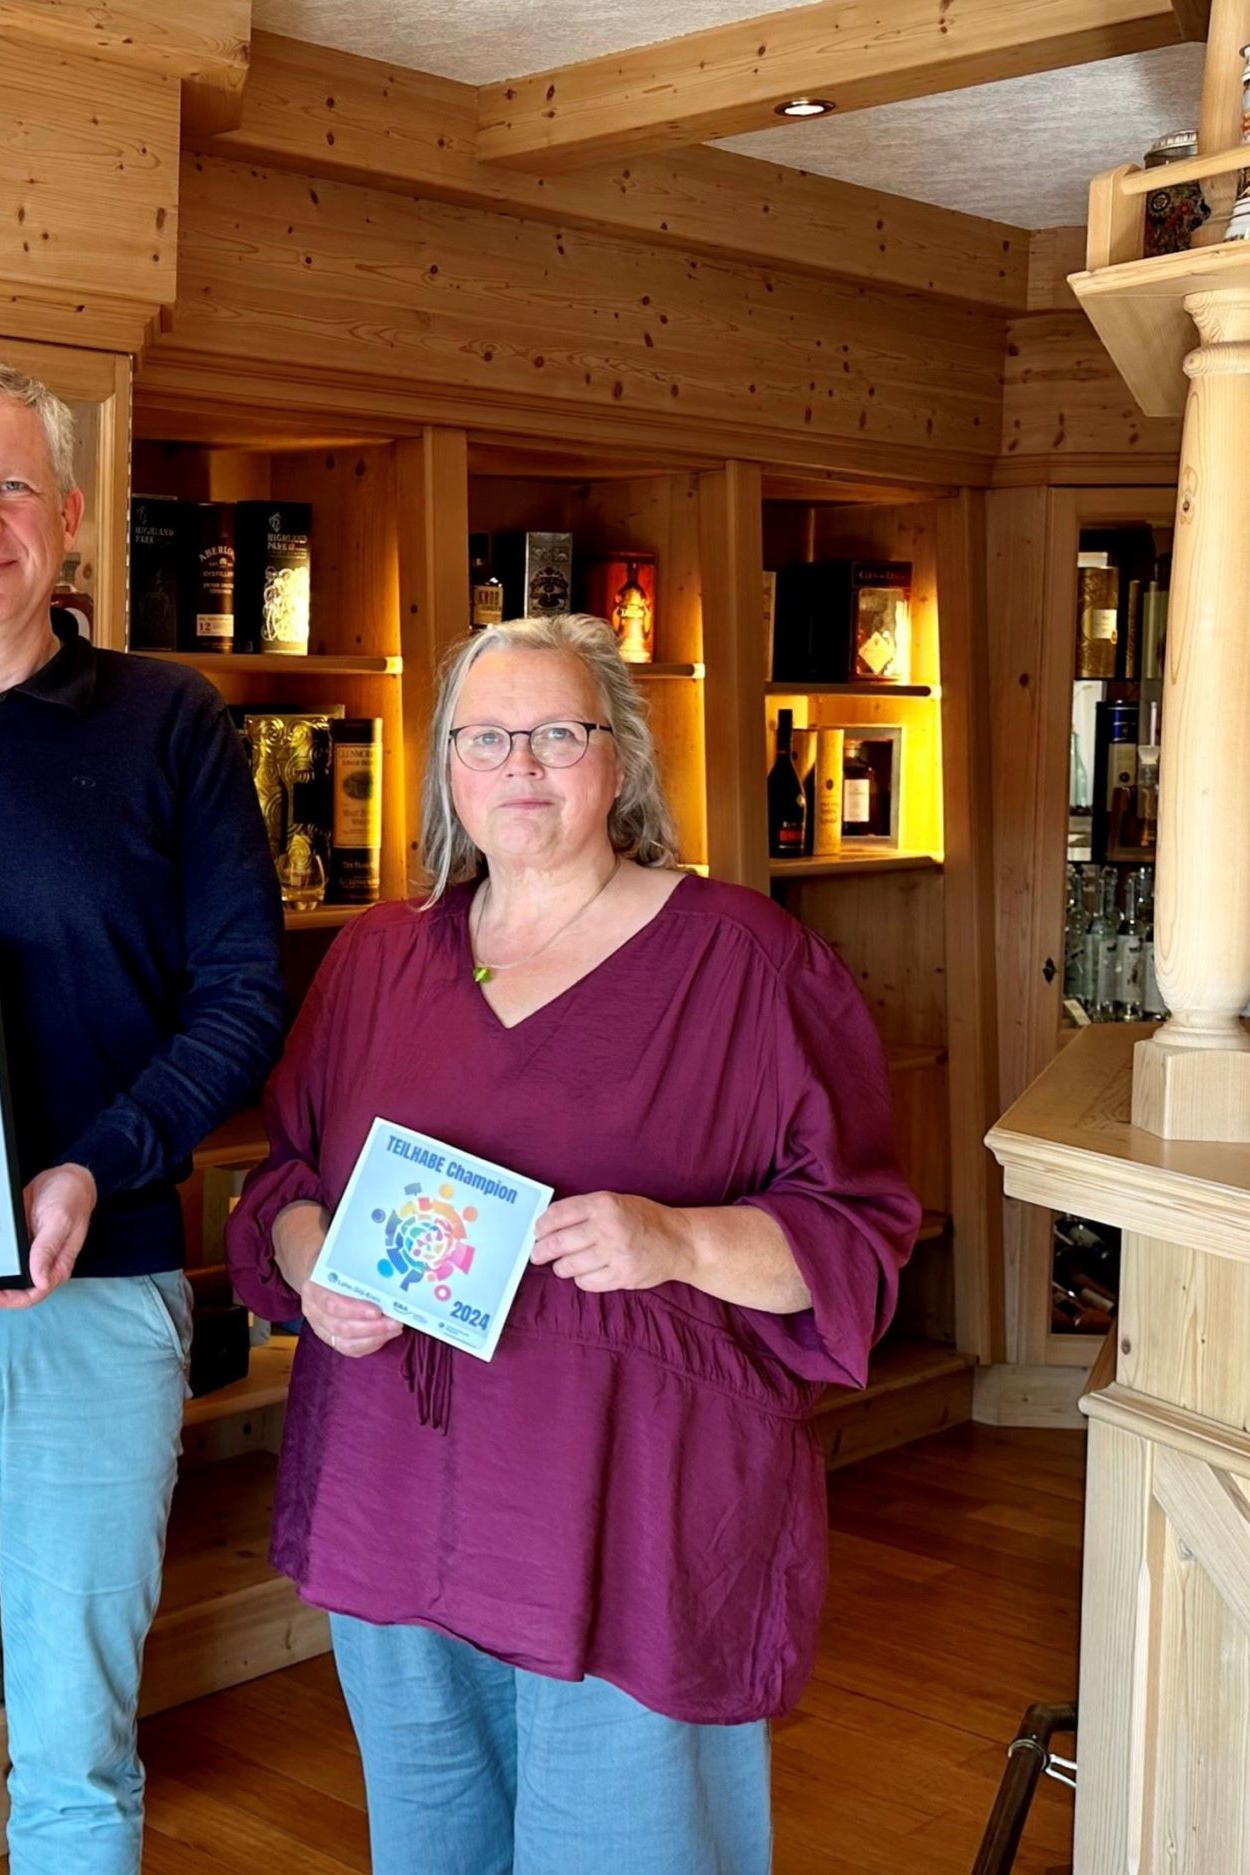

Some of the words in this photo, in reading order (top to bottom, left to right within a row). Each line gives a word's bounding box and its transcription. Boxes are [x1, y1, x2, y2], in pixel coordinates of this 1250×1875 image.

[198, 545, 235, 563] ABERLO
[386, 1135, 446, 1174] TEILHABE
[446, 1161, 518, 1205] Champion
[450, 1300, 491, 1332] 2024
